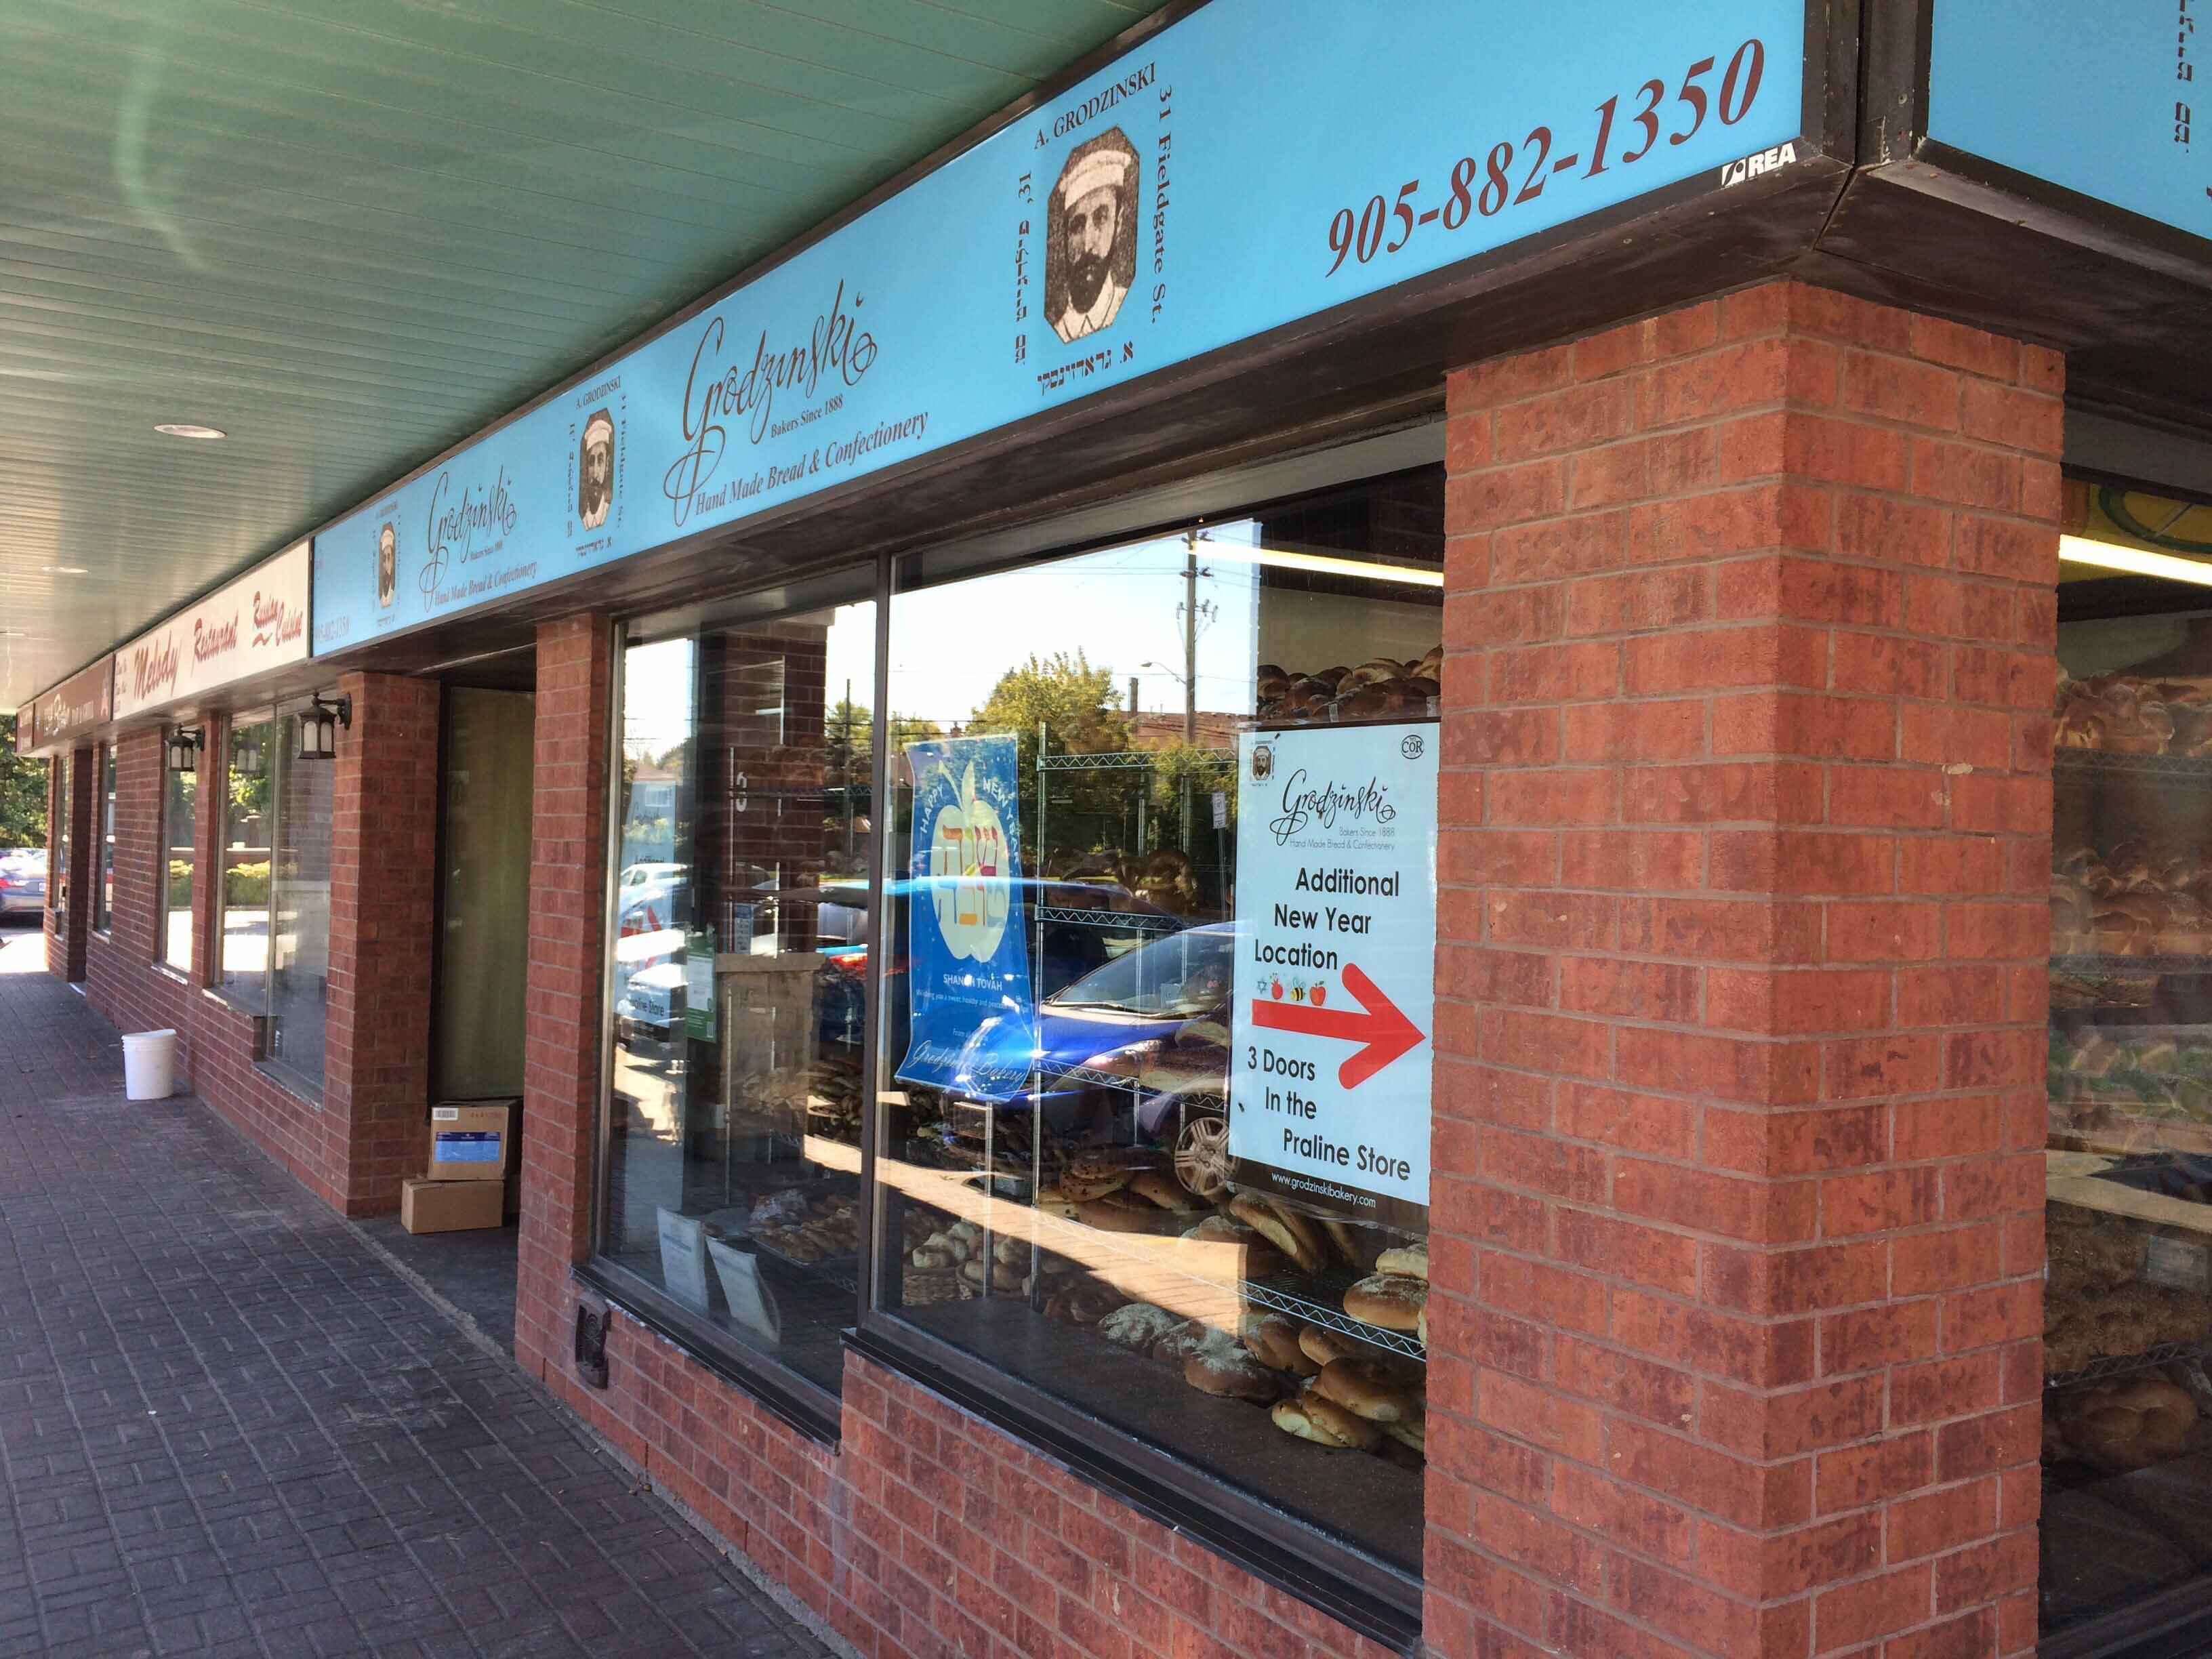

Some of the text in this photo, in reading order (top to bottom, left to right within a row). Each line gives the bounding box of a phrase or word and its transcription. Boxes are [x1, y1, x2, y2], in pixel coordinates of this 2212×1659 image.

[1034, 61, 1156, 150] A. GRODZINSKI
[1325, 39, 1764, 278] 905-882-1350
[1748, 142, 1797, 178] REA
[1152, 84, 1172, 324] 31 Fieldgate St.
[583, 375, 621, 407] GRODZINSKI
[663, 279, 878, 527] Grodzinski
[771, 392, 844, 438] Bakers Since 1888
[695, 411, 928, 516] Hand Made Bread & Confectionery
[419, 464, 517, 612] Grodzinski
[468, 575, 487, 596] Bread
[494, 561, 537, 588] Confectionery
[134, 630, 182, 701] Melody
[1401, 740, 1424, 754] COR
[920, 783, 943, 834] HAPPY
[983, 777, 1020, 864] NEW YEAR
[1269, 769, 1396, 846] Grodzinski
[1290, 839, 1307, 848] Hand
[1308, 840, 1326, 848] Made
[1328, 839, 1345, 849] Bread
[1347, 840, 1352, 849] &
[1338, 826, 1358, 836] Bakers
[1360, 827, 1376, 837] Since
[1295, 867, 1399, 897] Additional
[1274, 903, 1372, 934] New Year
[1255, 939, 1338, 970] Location
[943, 973, 1003, 991] SHANH TOVAH
[1248, 1046, 1315, 1082] 3 Doors
[1265, 1086, 1317, 1120] In the
[1284, 1128, 1410, 1181] Praline Store
[1271, 1172, 1376, 1208] www.grodzinskibakery.com
